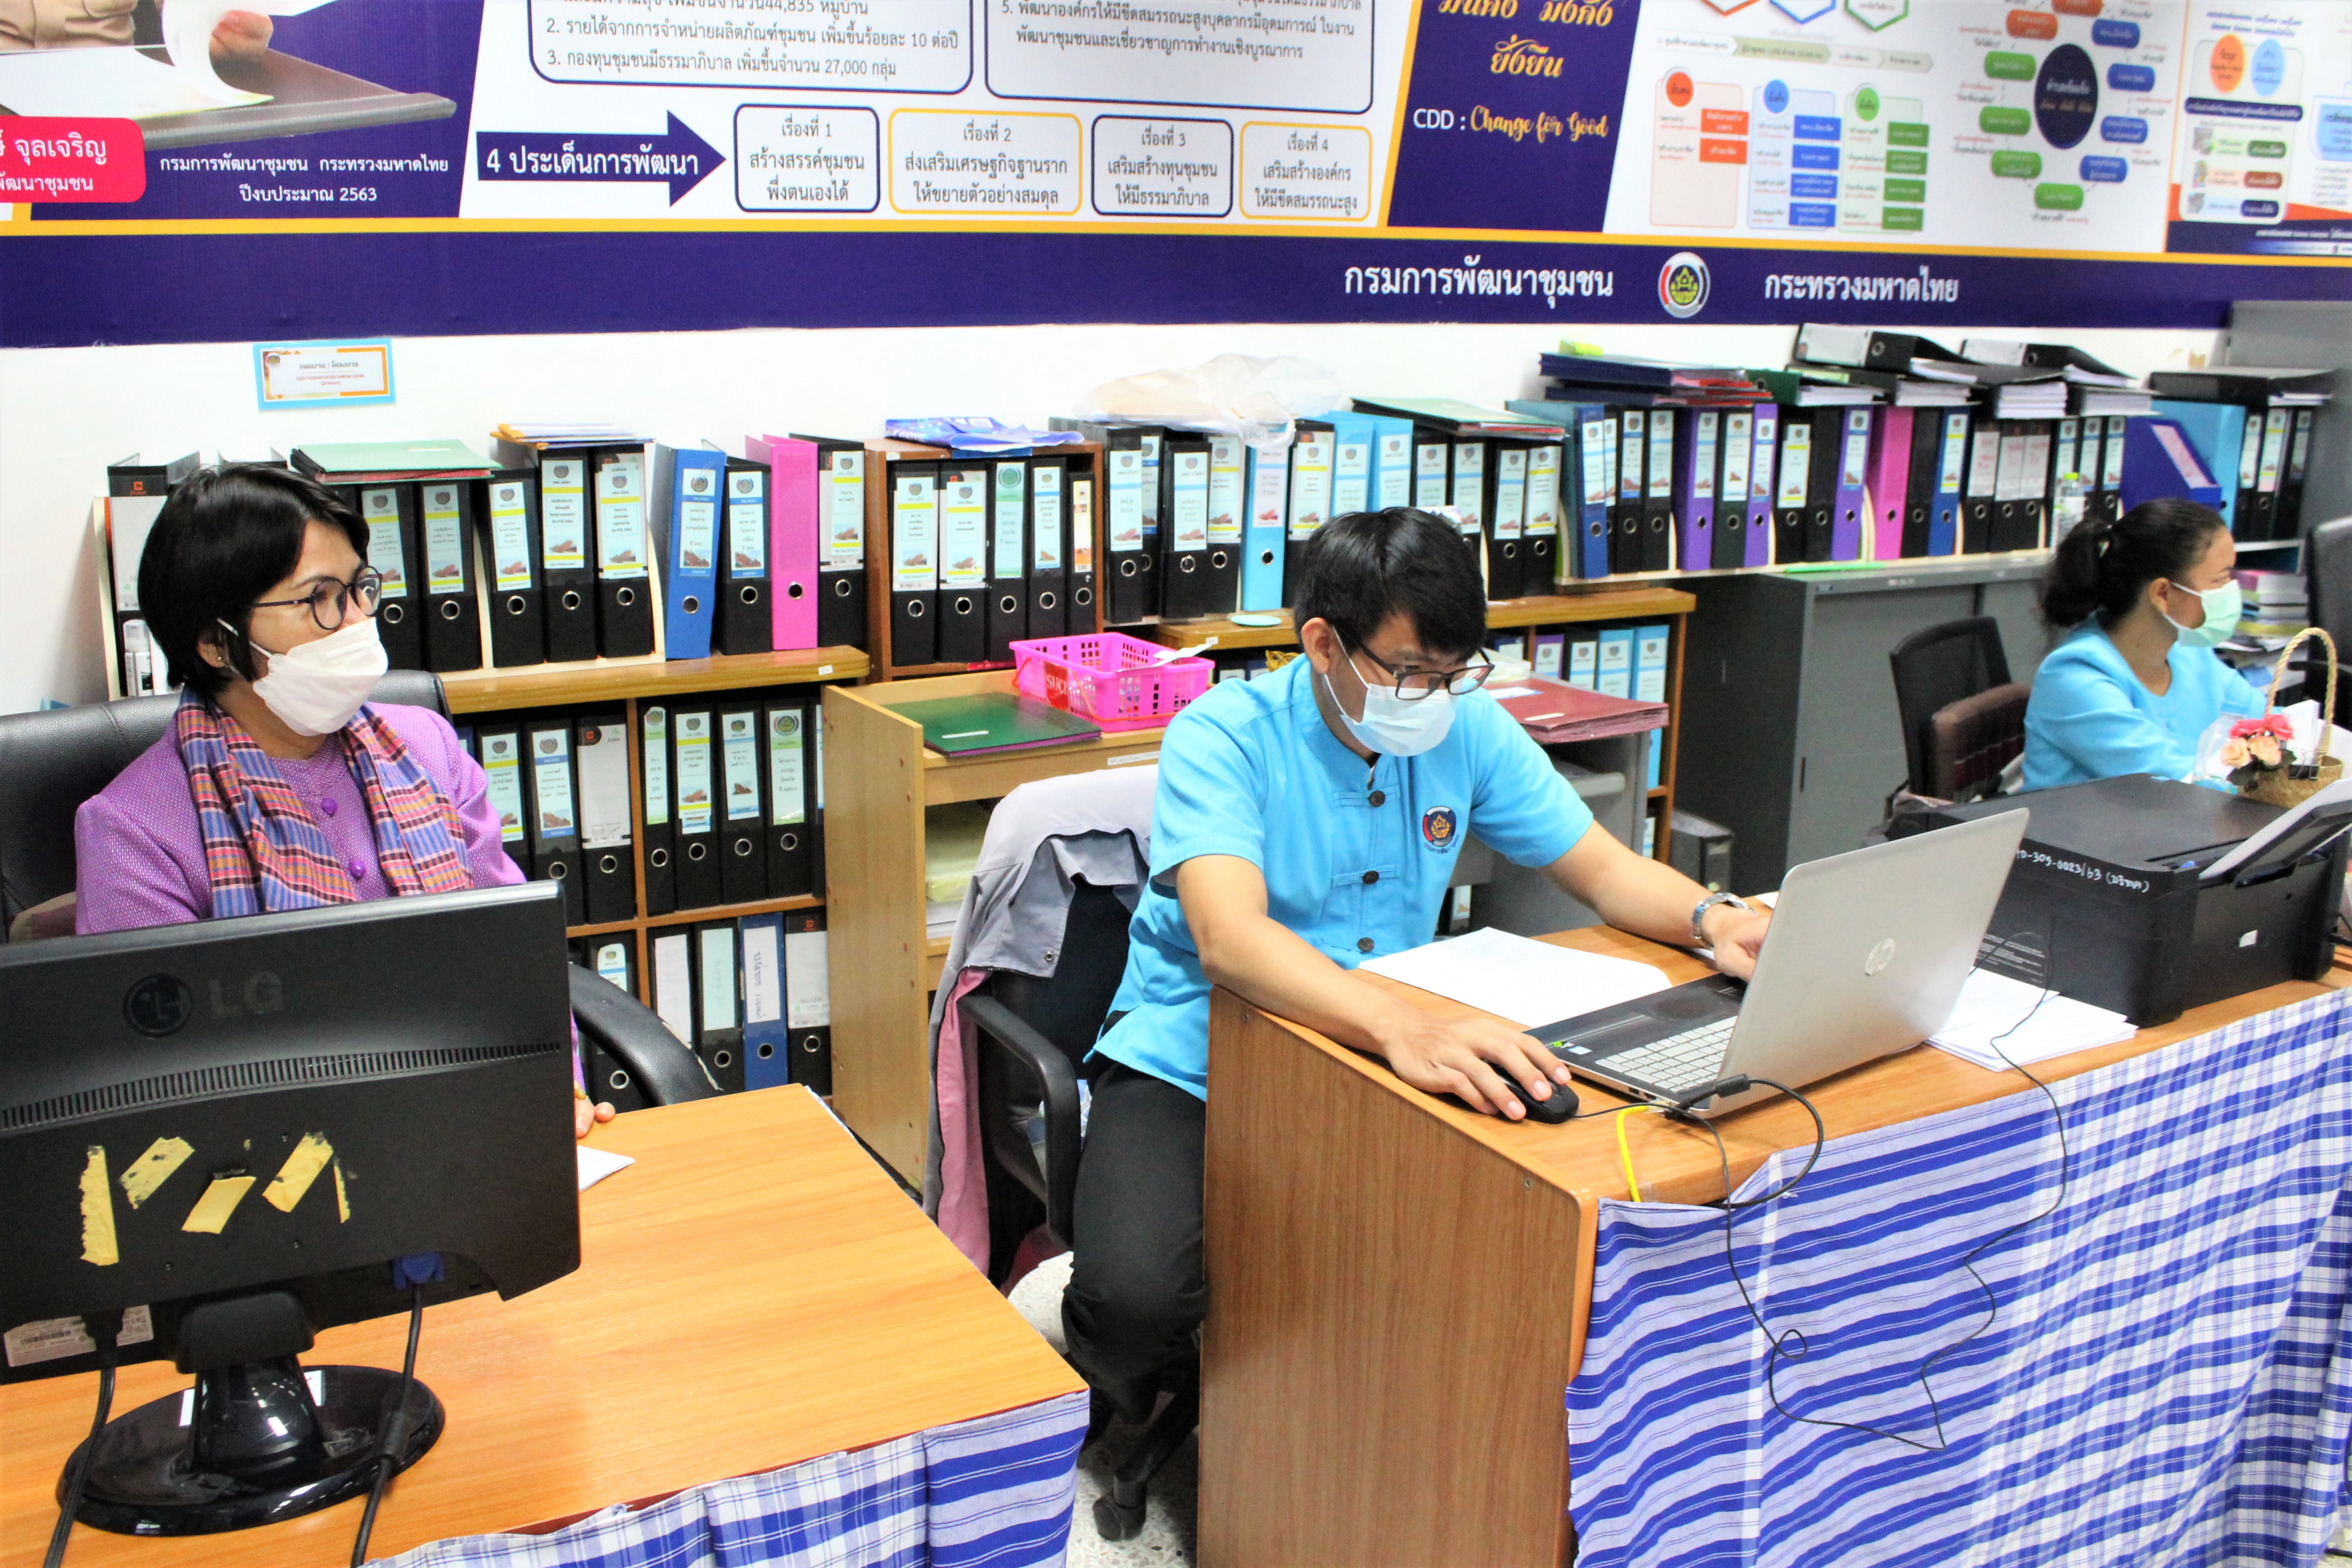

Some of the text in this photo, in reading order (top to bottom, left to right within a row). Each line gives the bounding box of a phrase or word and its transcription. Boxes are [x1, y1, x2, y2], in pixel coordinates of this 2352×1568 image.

[1001, 0, 1013, 14] 5.
[1320, 16, 1355, 36] ในงาน
[546, 18, 560, 34] 2.
[821, 20, 905, 47] เพิ่มขึ้นร้อยละ
[912, 33, 927, 48] 10
[932, 29, 959, 49] ต่อปี
[547, 47, 896, 81] 3. กองทุนชุมชนมีธรรมาภิบาล เพิ่มขึ้นจำนวน 27,000 กลุ่ม
[1490, 34, 1564, 78] ยั่งยืน
[781, 113, 832, 138] เรื่องที่ 1
[963, 119, 1011, 142] เรื่องที่ 2
[1142, 124, 1186, 147] เรื่องที่ 3
[1413, 108, 1455, 130] CDD
[1470, 104, 1535, 143] Change
[1536, 111, 1564, 144] for
[1566, 111, 1609, 142] Good
[14, 131, 107, 166] จุลเจริญ
[1287, 130, 1328, 152] เรื่องที่ 4
[160, 152, 449, 177] กรมการพัฒนาชุมชน กระทรวงมหาดไทย
[486, 141, 699, 176] 4 ประเด็นการพัฒนา
[750, 146, 865, 175] สร้างสรรค์ชุมชน
[905, 150, 1068, 180] ส่งเสริมเศรษฐกิจฐานราก
[1108, 155, 1218, 183] เสริมสร้างทุนชุมชน
[1263, 160, 1352, 182] เสริมสร้างองค์กร
[239, 183, 378, 202] ปีงบประมาณ 2563
[766, 180, 849, 203] พึ่งตนเองได้
[913, 181, 1059, 210] ให้ขยายตัวอย่างสมดุล
[1115, 183, 1209, 206] ให้มีธรรมาภิบาล
[1345, 255, 1960, 308] กรมการพัฒนาชุมชน กระทรวงมหาดไทย
[208, 971, 285, 1019] LG
